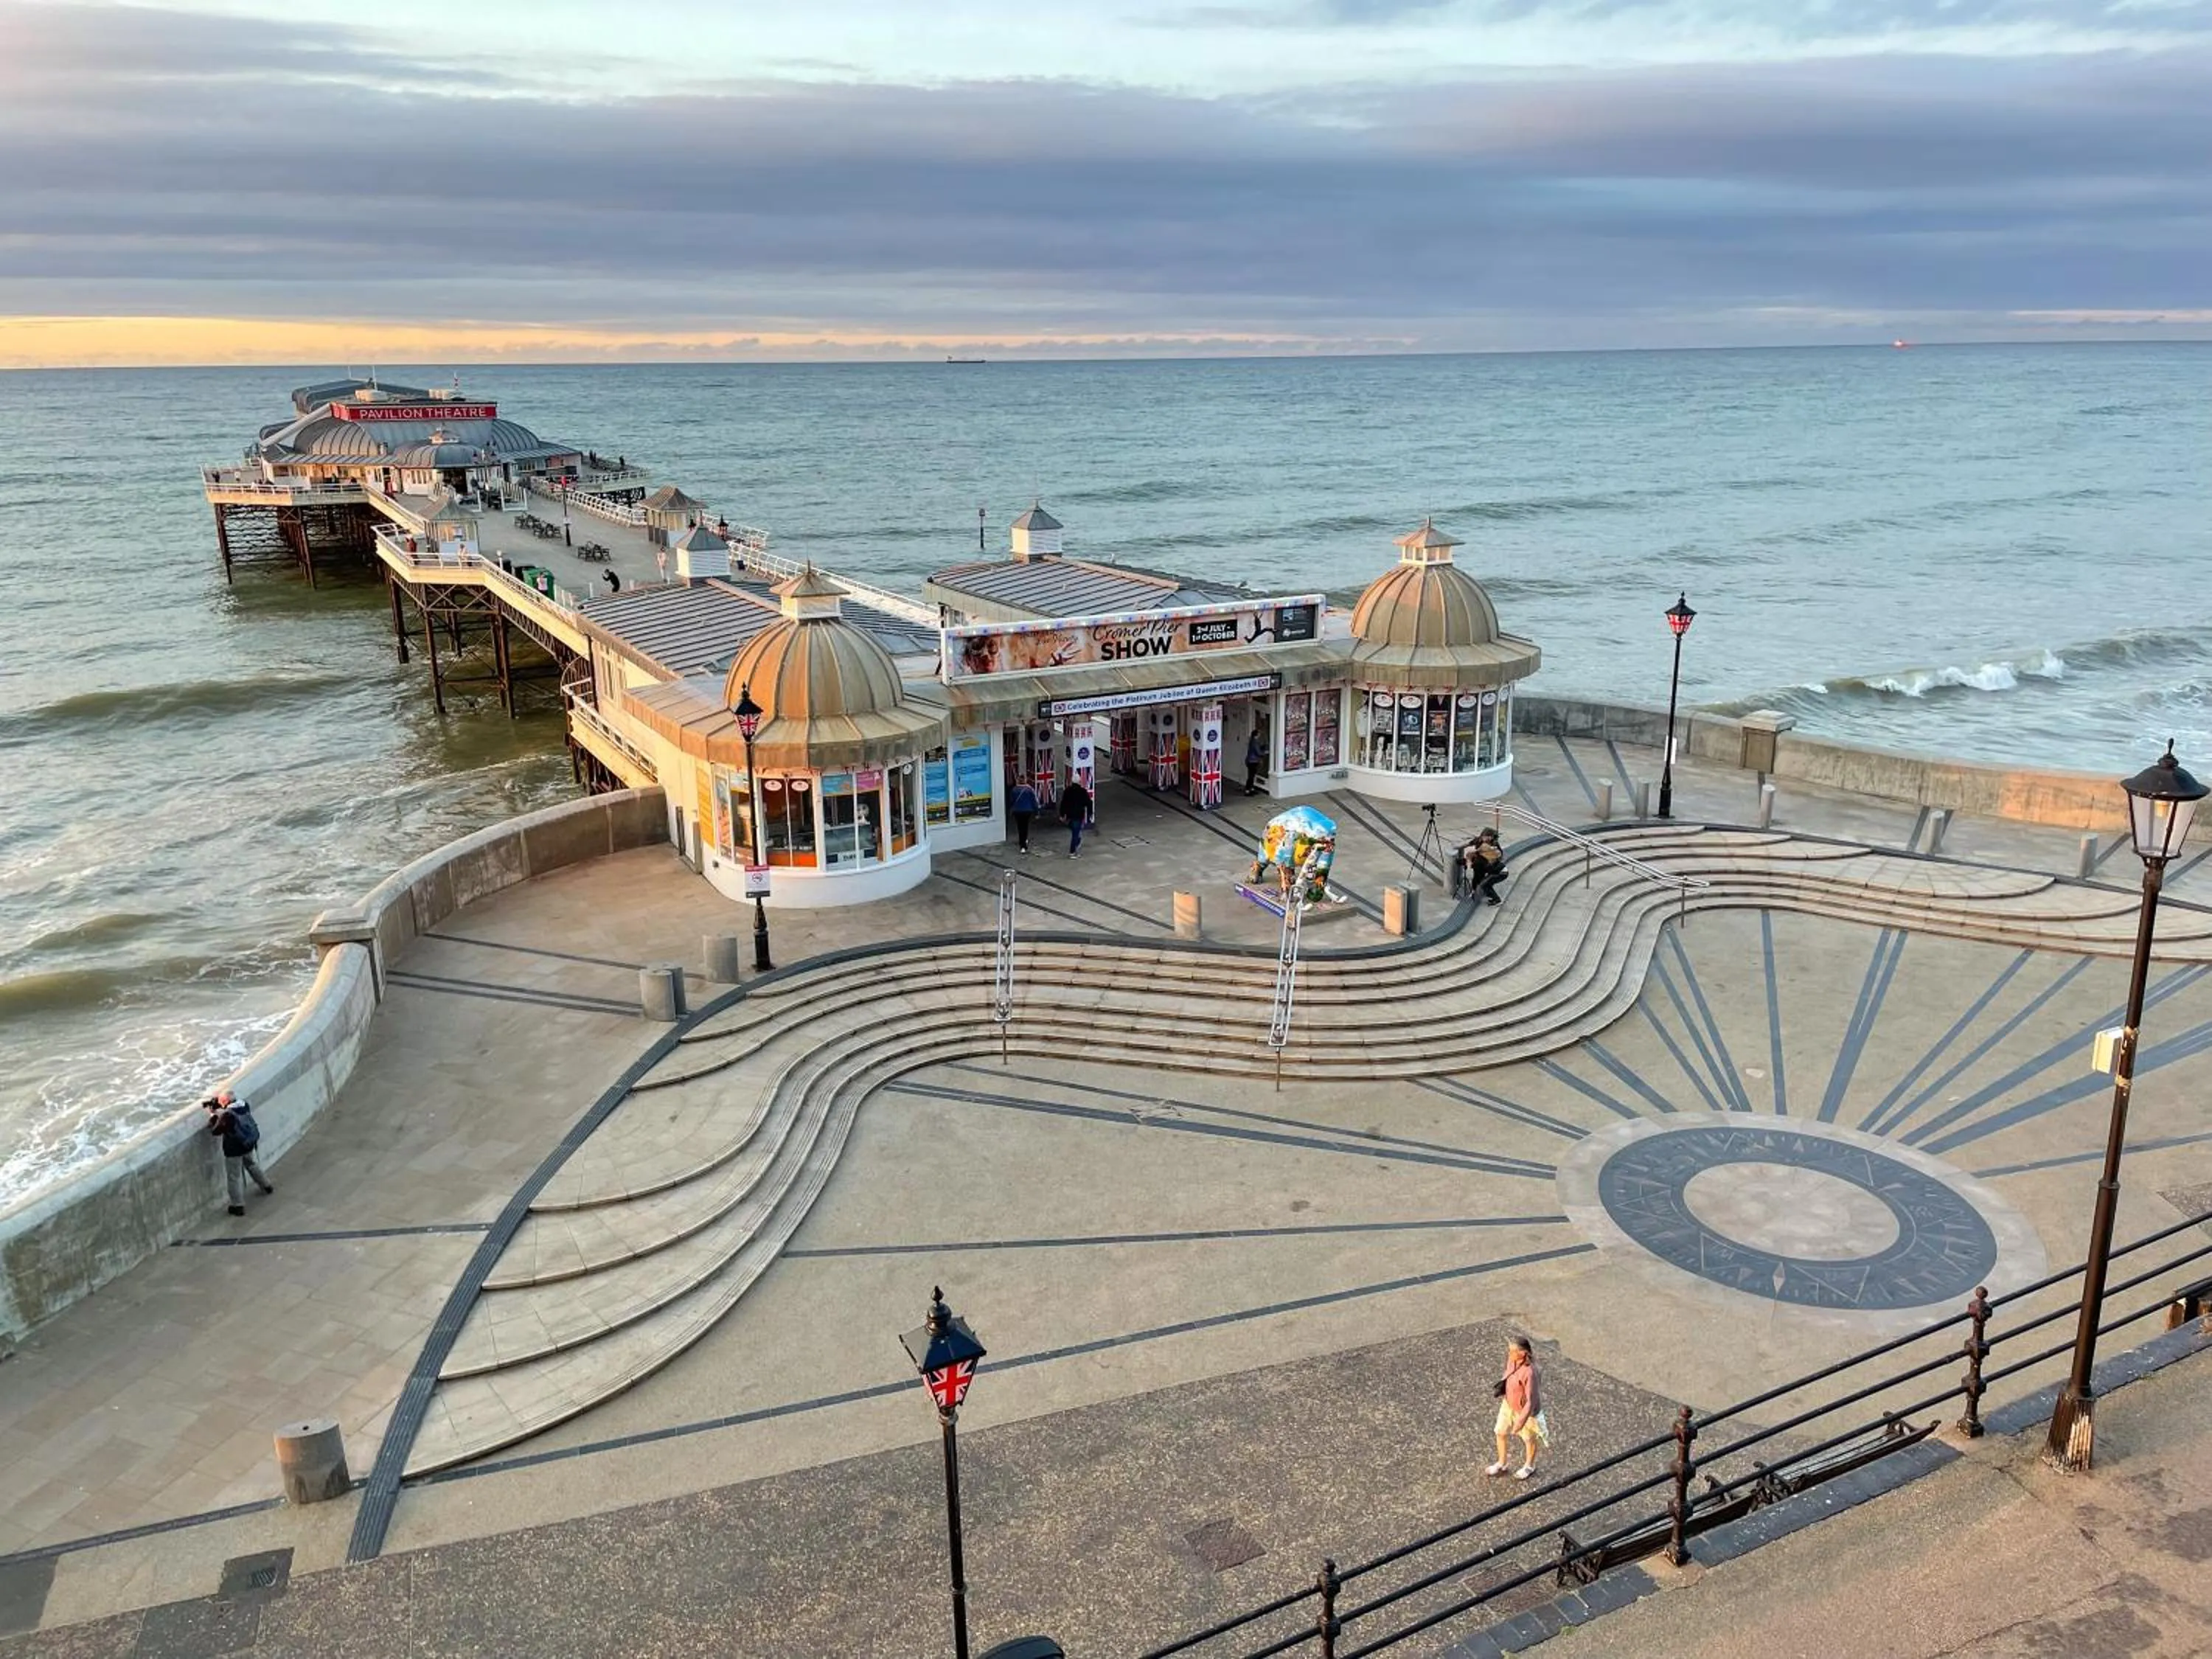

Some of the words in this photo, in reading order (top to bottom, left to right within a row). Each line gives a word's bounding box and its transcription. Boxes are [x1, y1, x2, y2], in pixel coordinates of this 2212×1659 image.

[359, 408, 423, 420] PAVILION
[427, 406, 487, 418] THEATRE
[1092, 625, 1147, 641] Cromer
[1147, 619, 1182, 634] Pier
[1201, 630, 1235, 641] OCTOBER
[1209, 624, 1226, 632] JULY
[1101, 636, 1172, 661] SHOW
[1067, 700, 1110, 710] Celebrating
[1111, 697, 1124, 705] the
[1127, 694, 1157, 703] Platinum
[1159, 689, 1184, 699] Jubilee
[1219, 682, 1251, 691] Elizabeth
